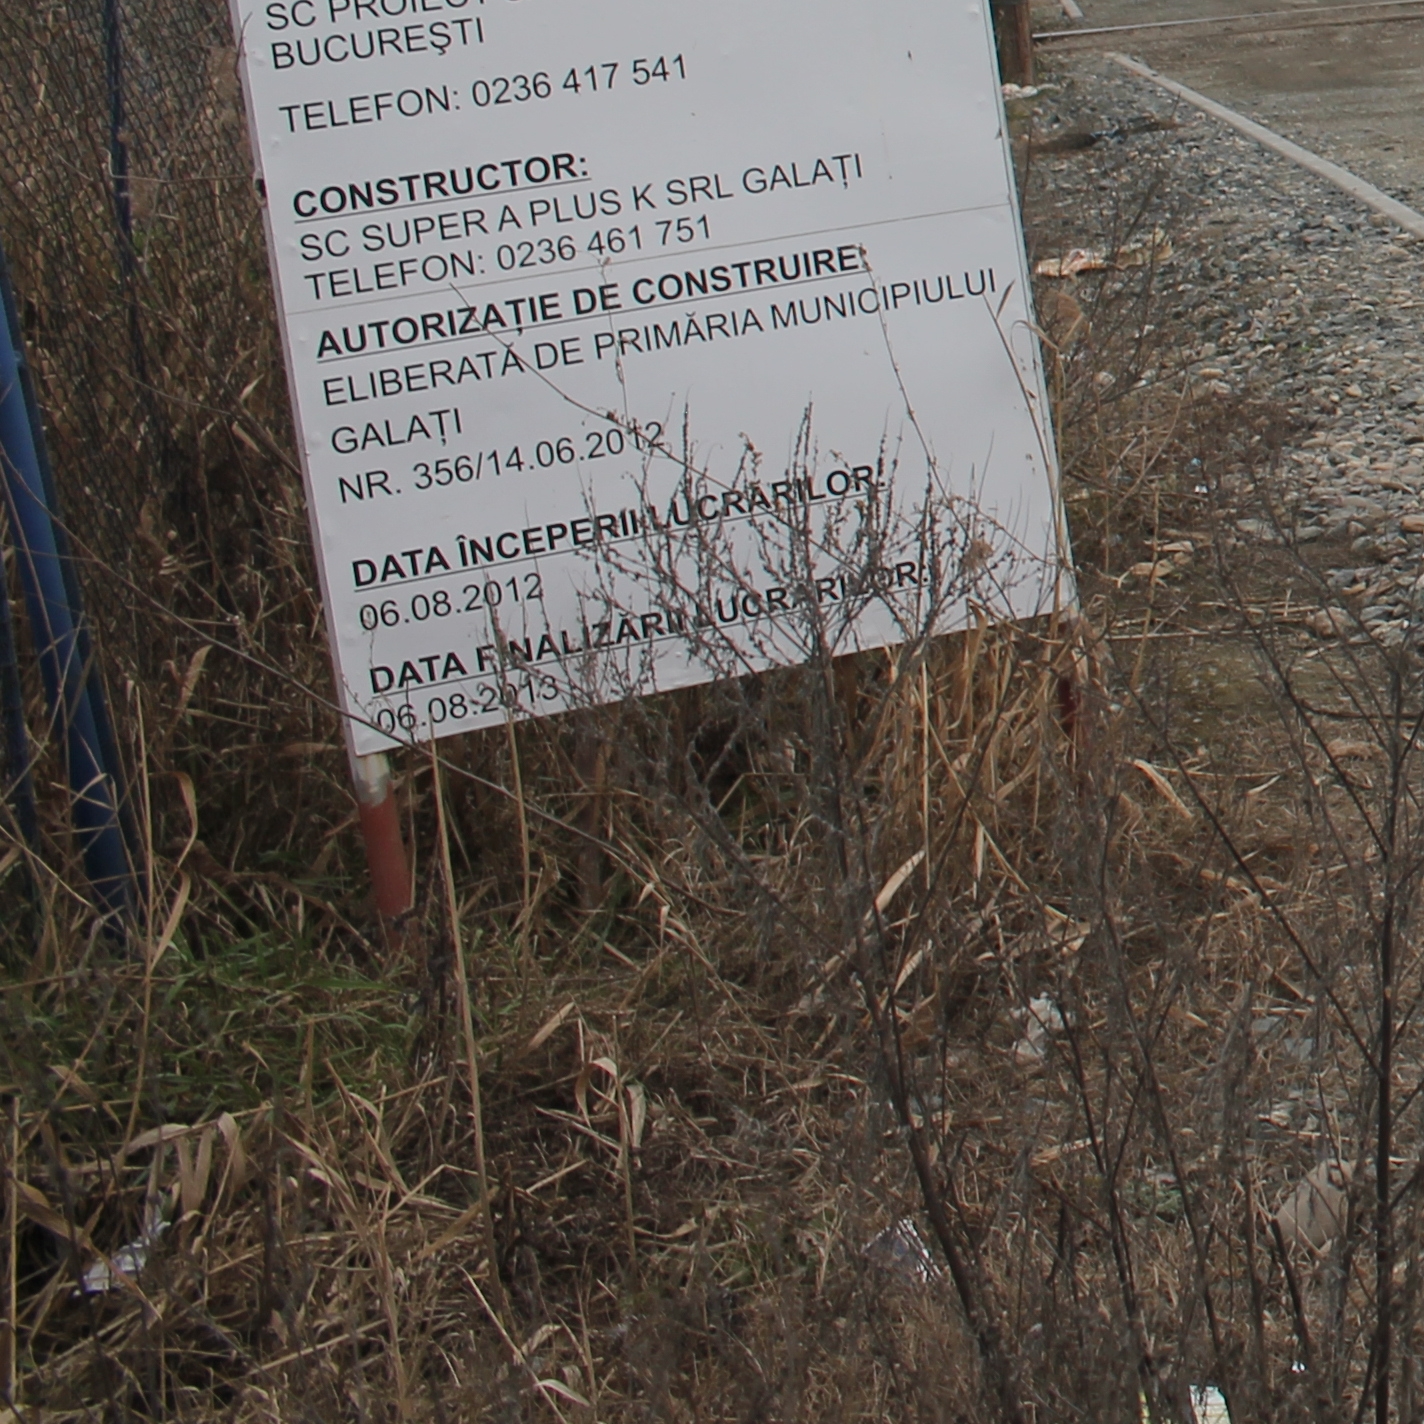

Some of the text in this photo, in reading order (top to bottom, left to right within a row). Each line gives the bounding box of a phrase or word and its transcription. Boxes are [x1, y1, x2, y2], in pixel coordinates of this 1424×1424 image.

[265, 1, 317, 31] SC
[279, 55, 688, 133] TELEFON: 0236 417 541
[293, 153, 588, 219] CONSTRUCTOR:
[298, 232, 350, 261] SC
[362, 209, 488, 251] SUPER
[497, 207, 522, 232] A
[529, 191, 622, 226] PLUS
[632, 185, 657, 209] K
[667, 171, 732, 204] SRL
[304, 216, 712, 301] TELEFON: 0236 461 751
[323, 268, 997, 407] ELIBERATĂ DE PRIMĂRIA MUNICIPIULUI
[573, 285, 623, 313] DE
[338, 422, 664, 504] NR. 356/14.06.2012
[353, 547, 450, 588] DATA
[456, 509, 639, 565] ÎNCEPERII
[359, 574, 545, 633] 06.08.2012
[370, 652, 467, 695] DATA
[476, 611, 685, 672] FNALIZĂRII
